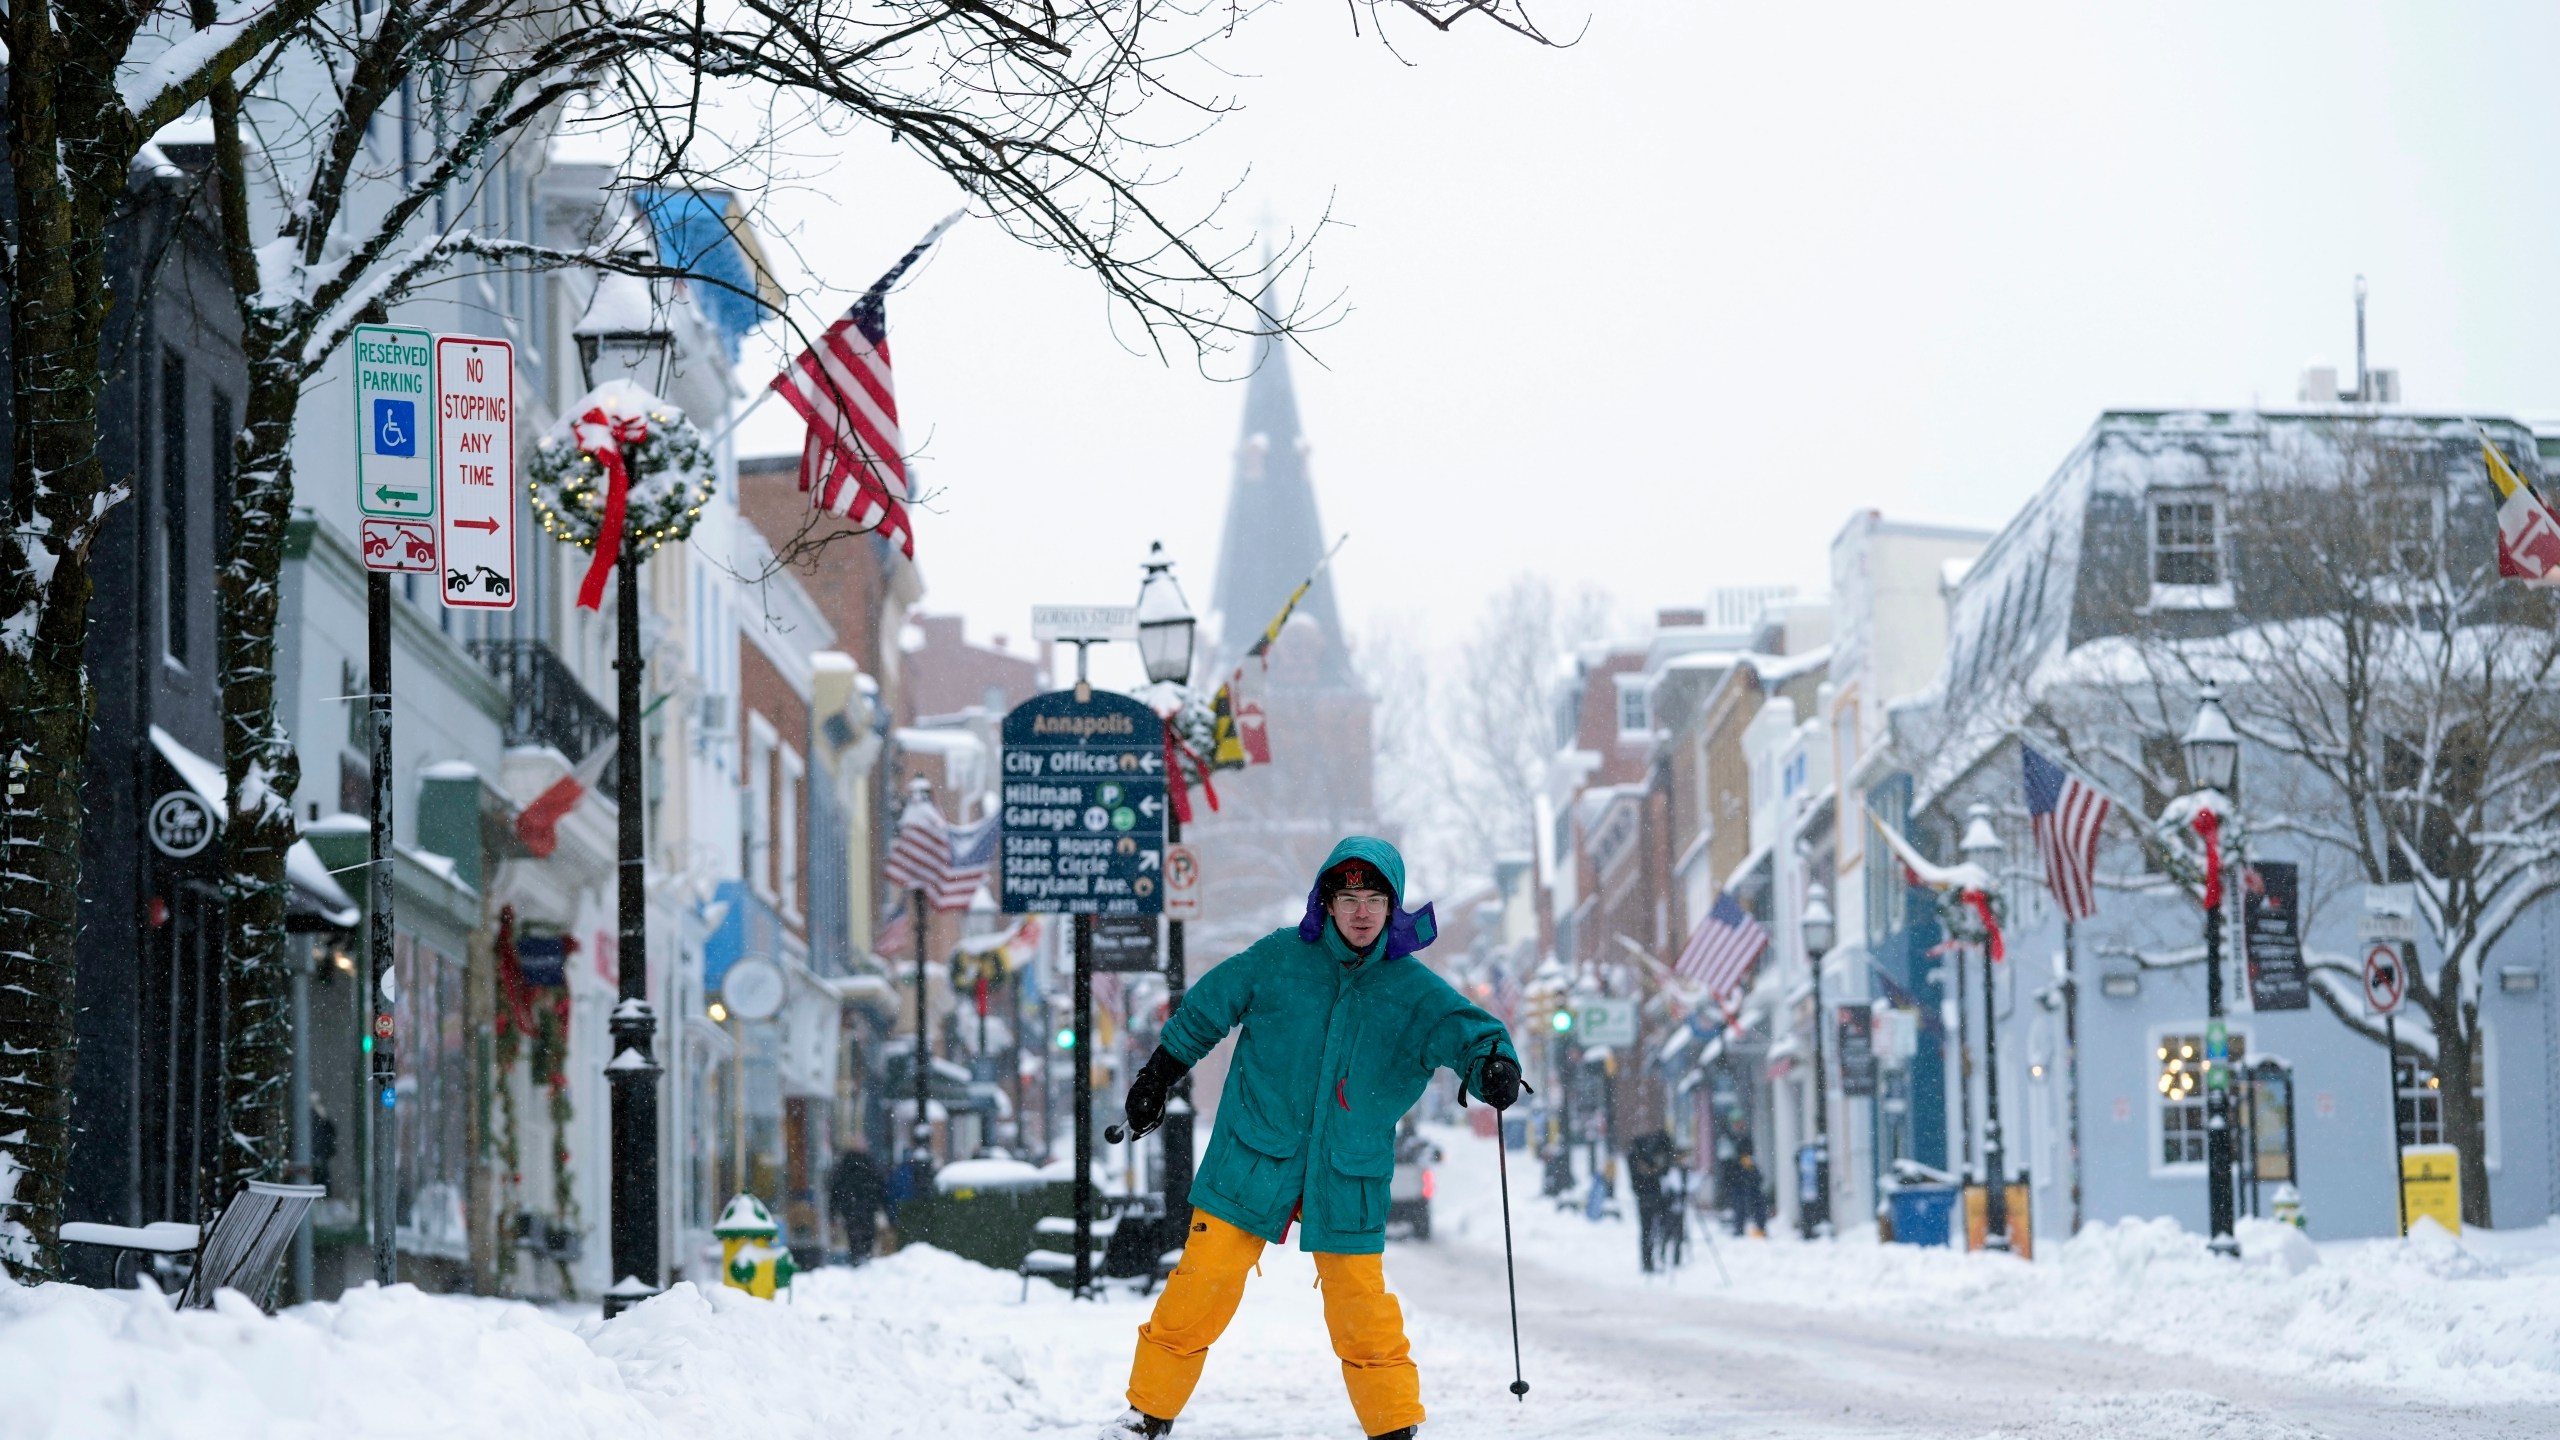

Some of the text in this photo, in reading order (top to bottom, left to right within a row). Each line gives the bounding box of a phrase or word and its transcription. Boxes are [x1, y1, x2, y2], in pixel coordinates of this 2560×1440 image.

[359, 343, 428, 367] RESERVED
[363, 370, 423, 394] PARKING
[466, 358, 484, 383] NO
[445, 394, 506, 422] STOPPING
[460, 433, 492, 454] ANY
[459, 464, 494, 486] TIME
[1033, 608, 1135, 625] GORMAN STREET
[1033, 713, 1134, 738] Annapolis
[1005, 750, 1118, 777] City Offices
[1005, 783, 1082, 804] Hillman
[1005, 806, 1077, 831] Garage
[1005, 836, 1114, 856] State House
[1005, 855, 1109, 875] State Circle
[1006, 875, 1132, 899] Maryland Ave.
[1345, 870, 1364, 888] M
